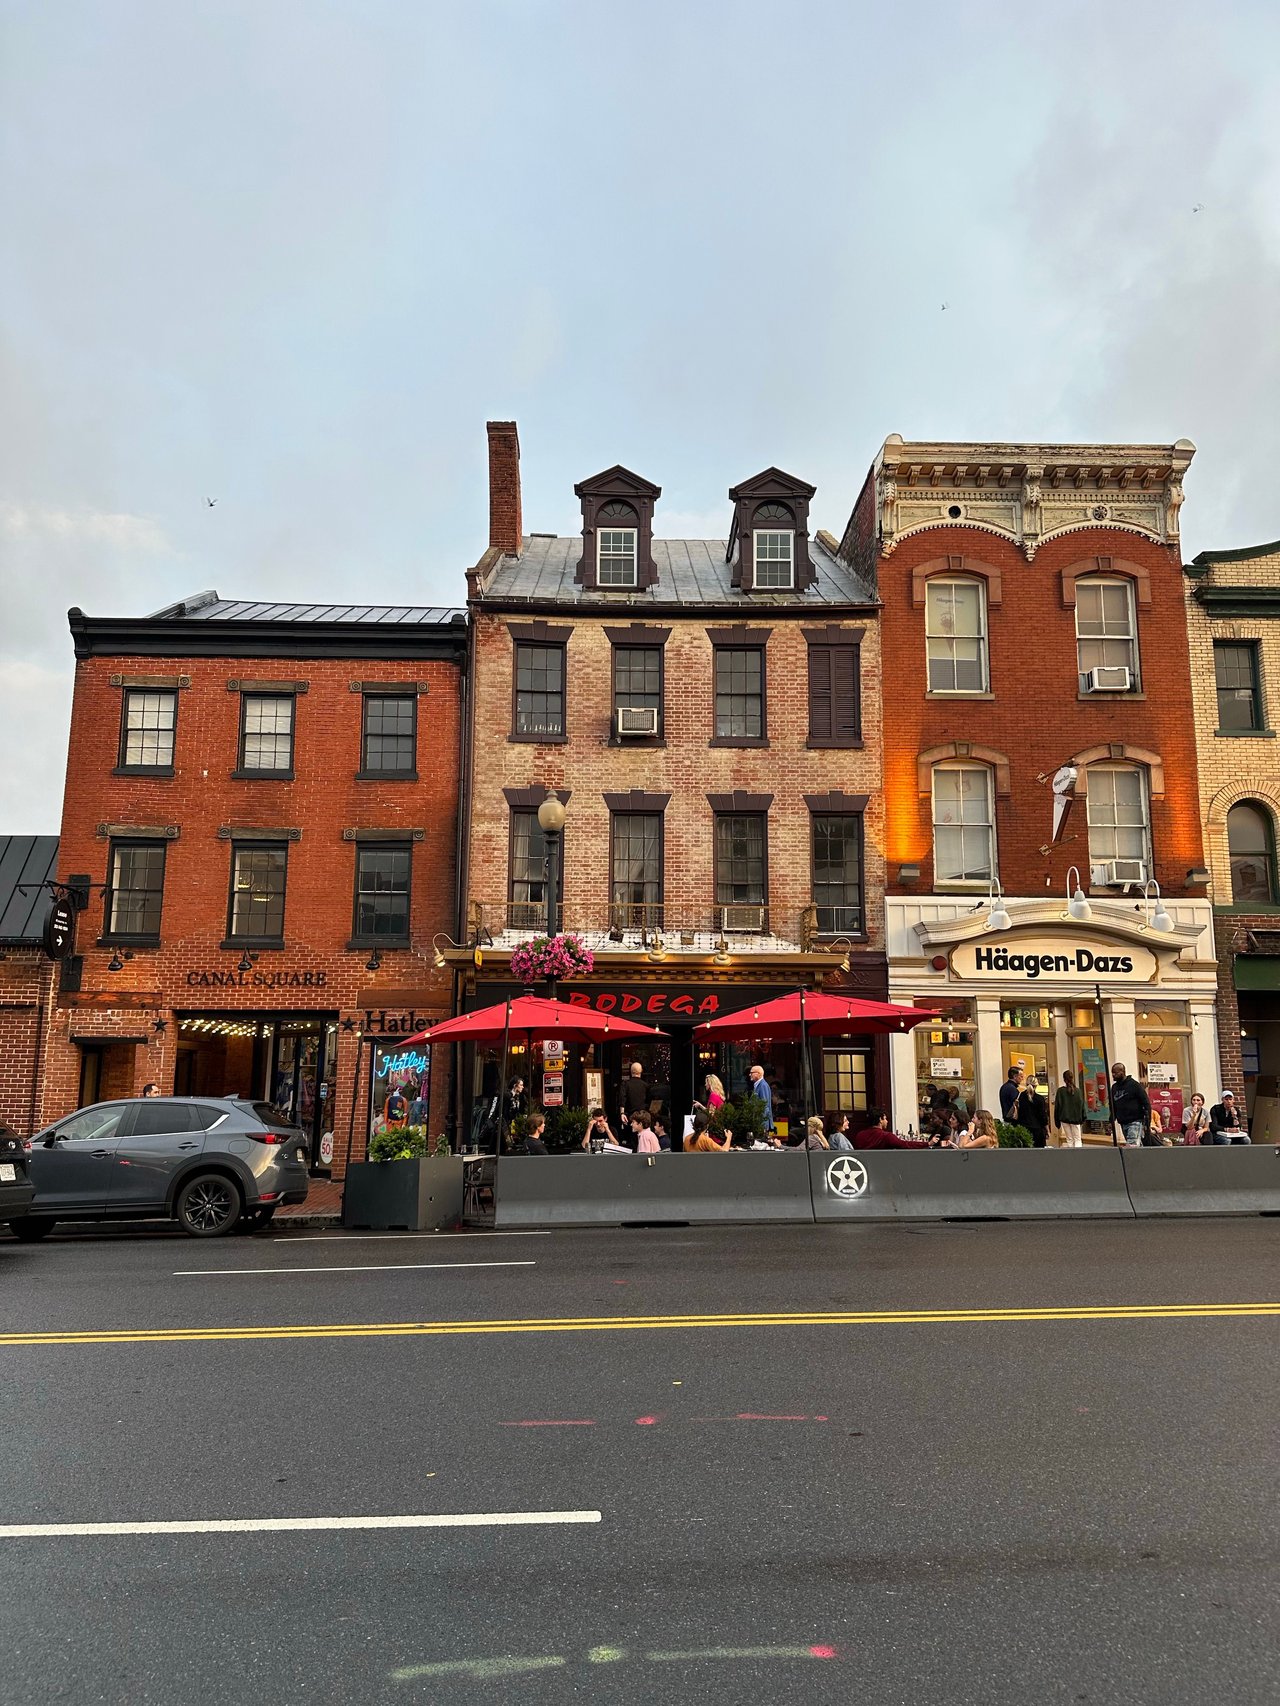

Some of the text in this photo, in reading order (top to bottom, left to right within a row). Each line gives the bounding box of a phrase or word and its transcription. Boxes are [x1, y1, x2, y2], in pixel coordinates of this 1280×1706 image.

[975, 947, 1133, 978] Häagen-Dazs
[187, 972, 327, 989] CANAL SQUARE
[569, 992, 719, 1015] BODEGA
[378, 1051, 427, 1077] Hatley
